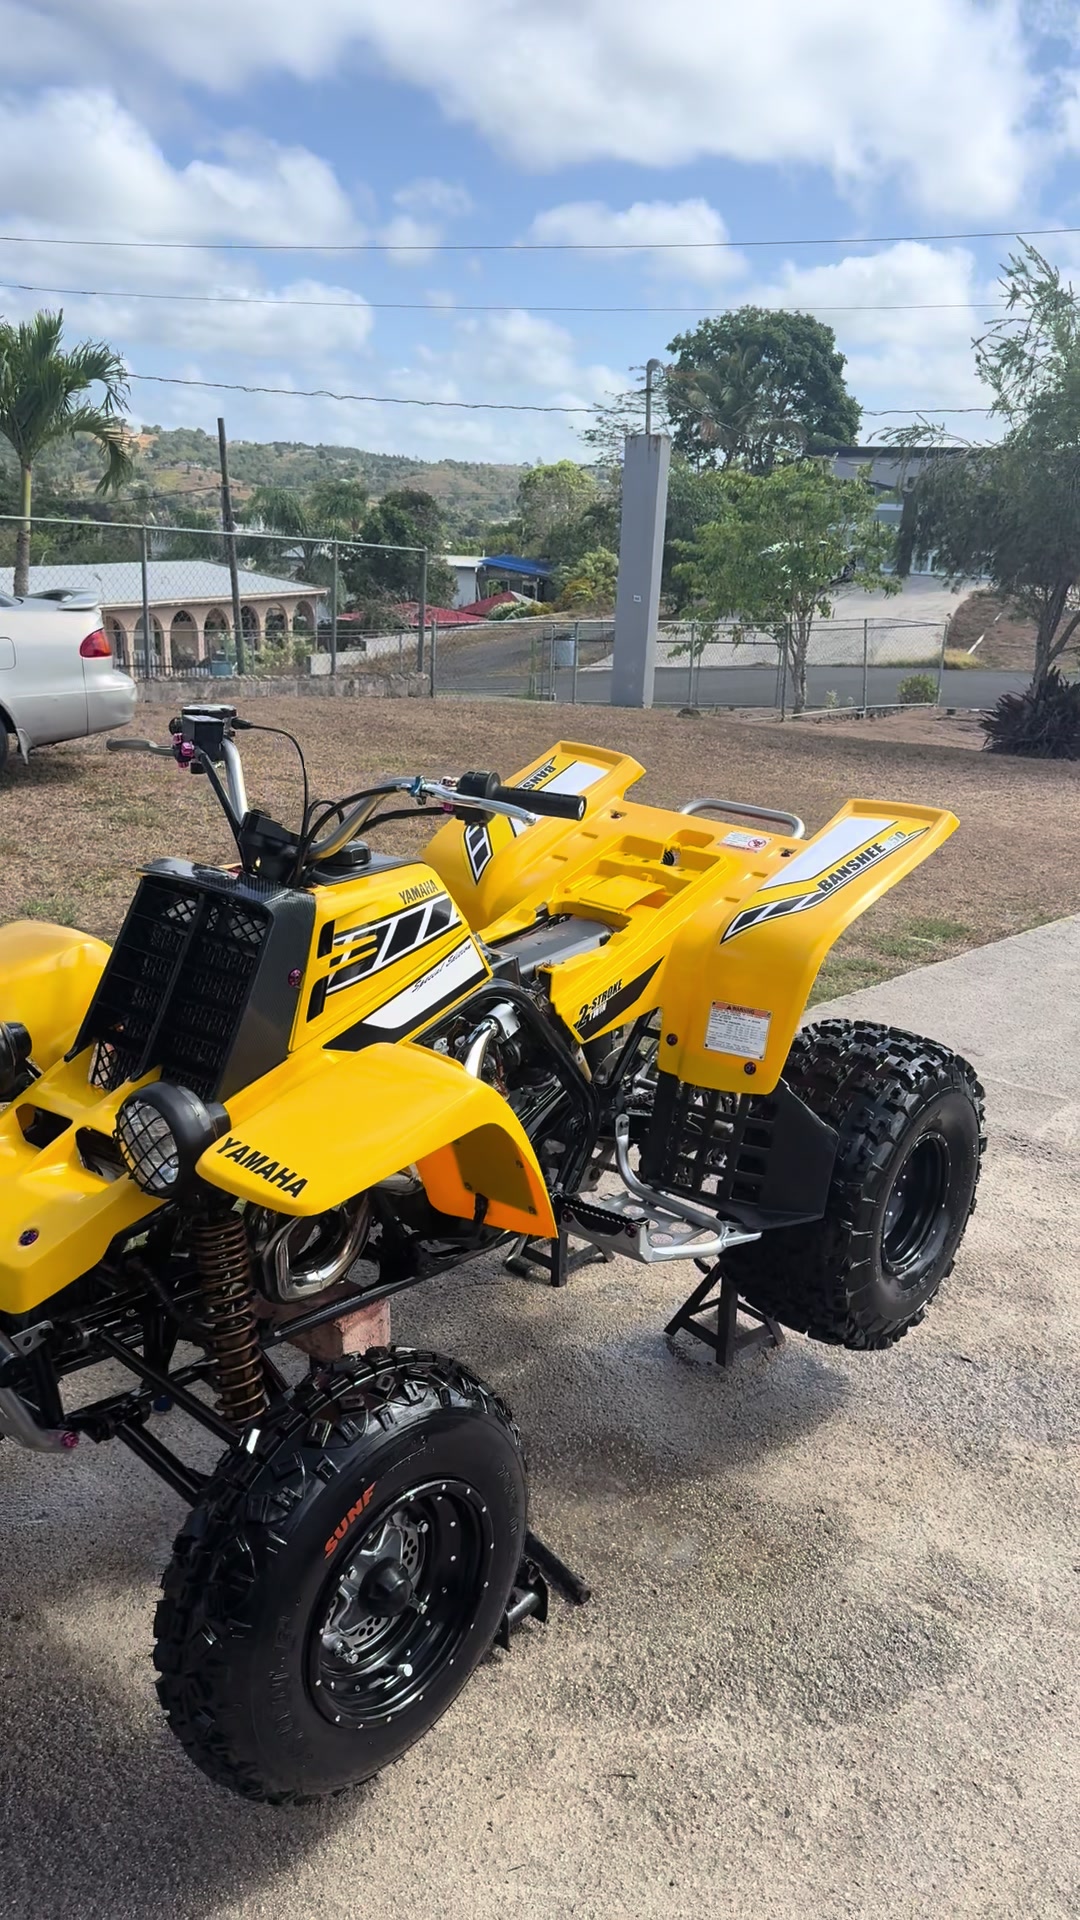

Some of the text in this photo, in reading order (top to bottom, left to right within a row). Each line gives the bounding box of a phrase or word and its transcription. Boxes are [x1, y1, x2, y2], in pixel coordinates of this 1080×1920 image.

[521, 765, 557, 791] BANS
[398, 879, 439, 905] YAMAHA
[817, 842, 887, 893] BANSHEE
[575, 978, 623, 1030] 2-STROKE
[216, 1137, 309, 1199] YAMAHA
[324, 1480, 377, 1560] SUNF
